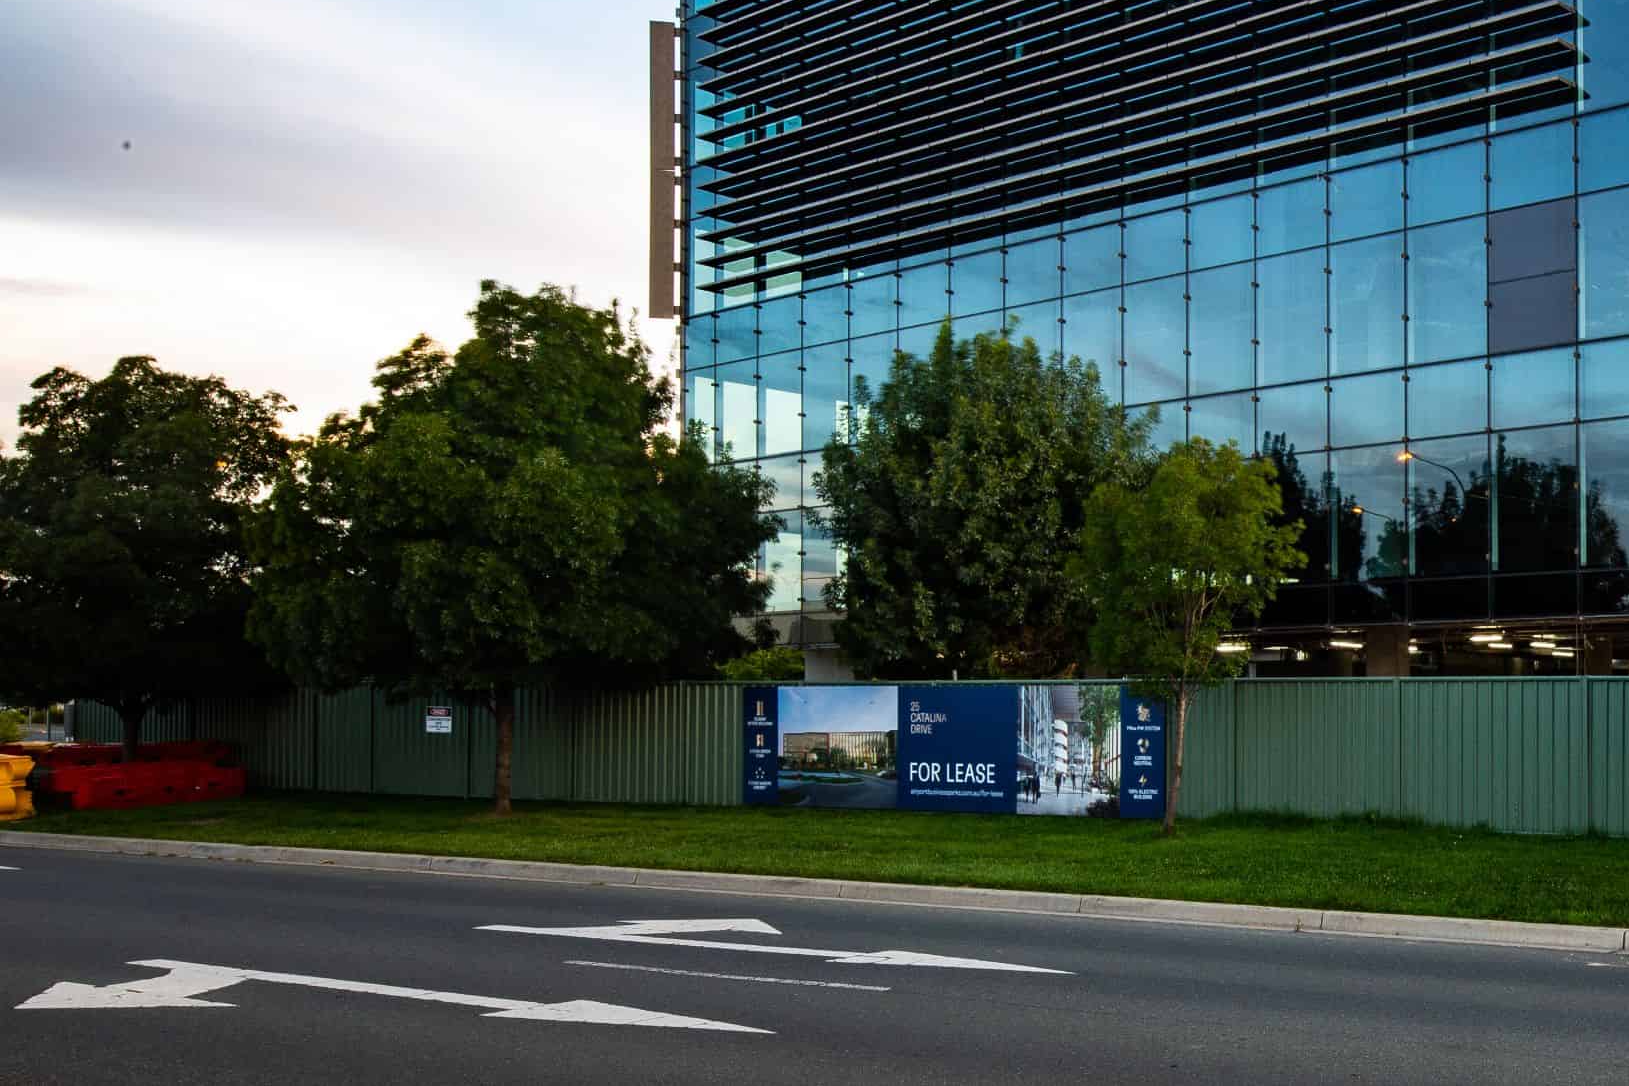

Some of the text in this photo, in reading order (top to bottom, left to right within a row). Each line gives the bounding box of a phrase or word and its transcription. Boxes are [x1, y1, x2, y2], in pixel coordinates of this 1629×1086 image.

[910, 712, 947, 723] CATALINA
[910, 724, 932, 734] DRIVE
[909, 762, 996, 784] FOR LEASE
